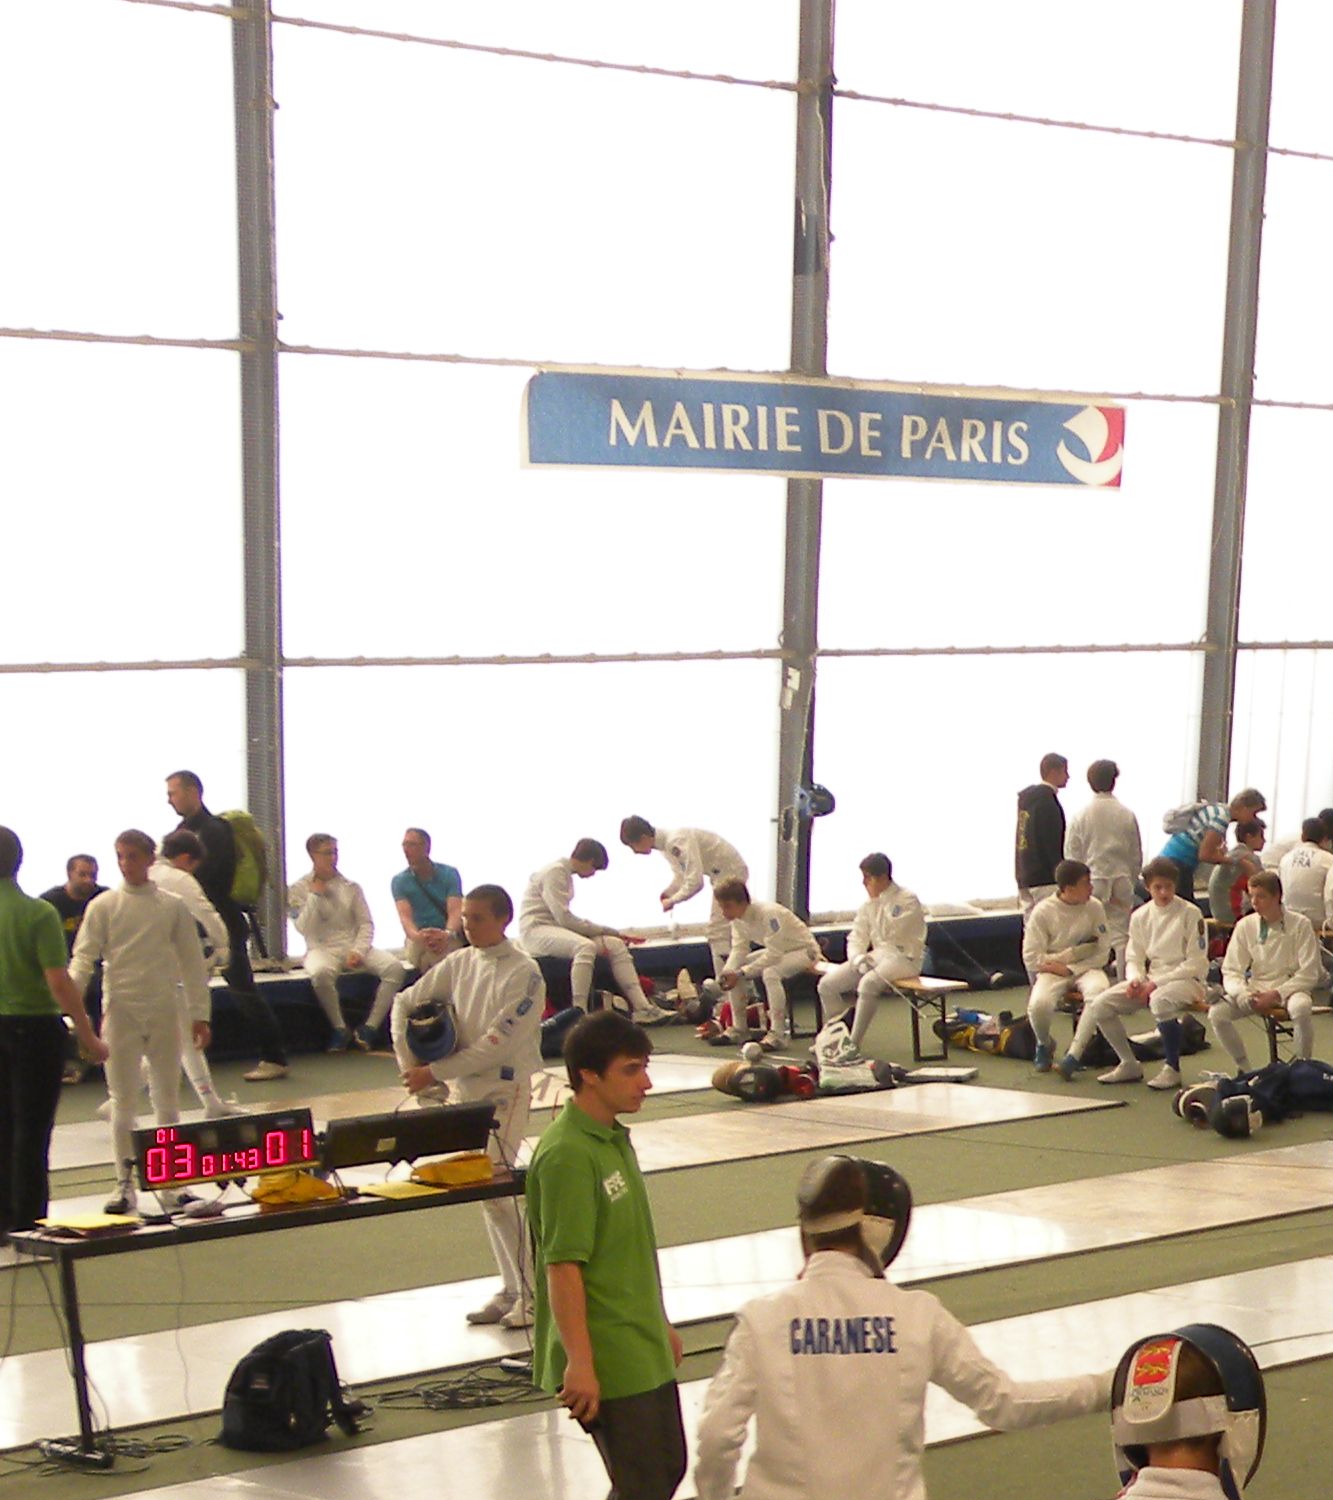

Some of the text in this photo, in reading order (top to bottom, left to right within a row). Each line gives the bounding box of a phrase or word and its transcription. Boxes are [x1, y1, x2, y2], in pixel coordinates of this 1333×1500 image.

[609, 398, 1030, 465] MAIRIE DE PARIS
[146, 1144, 194, 1183] 03
[201, 1148, 259, 1176] 01:43
